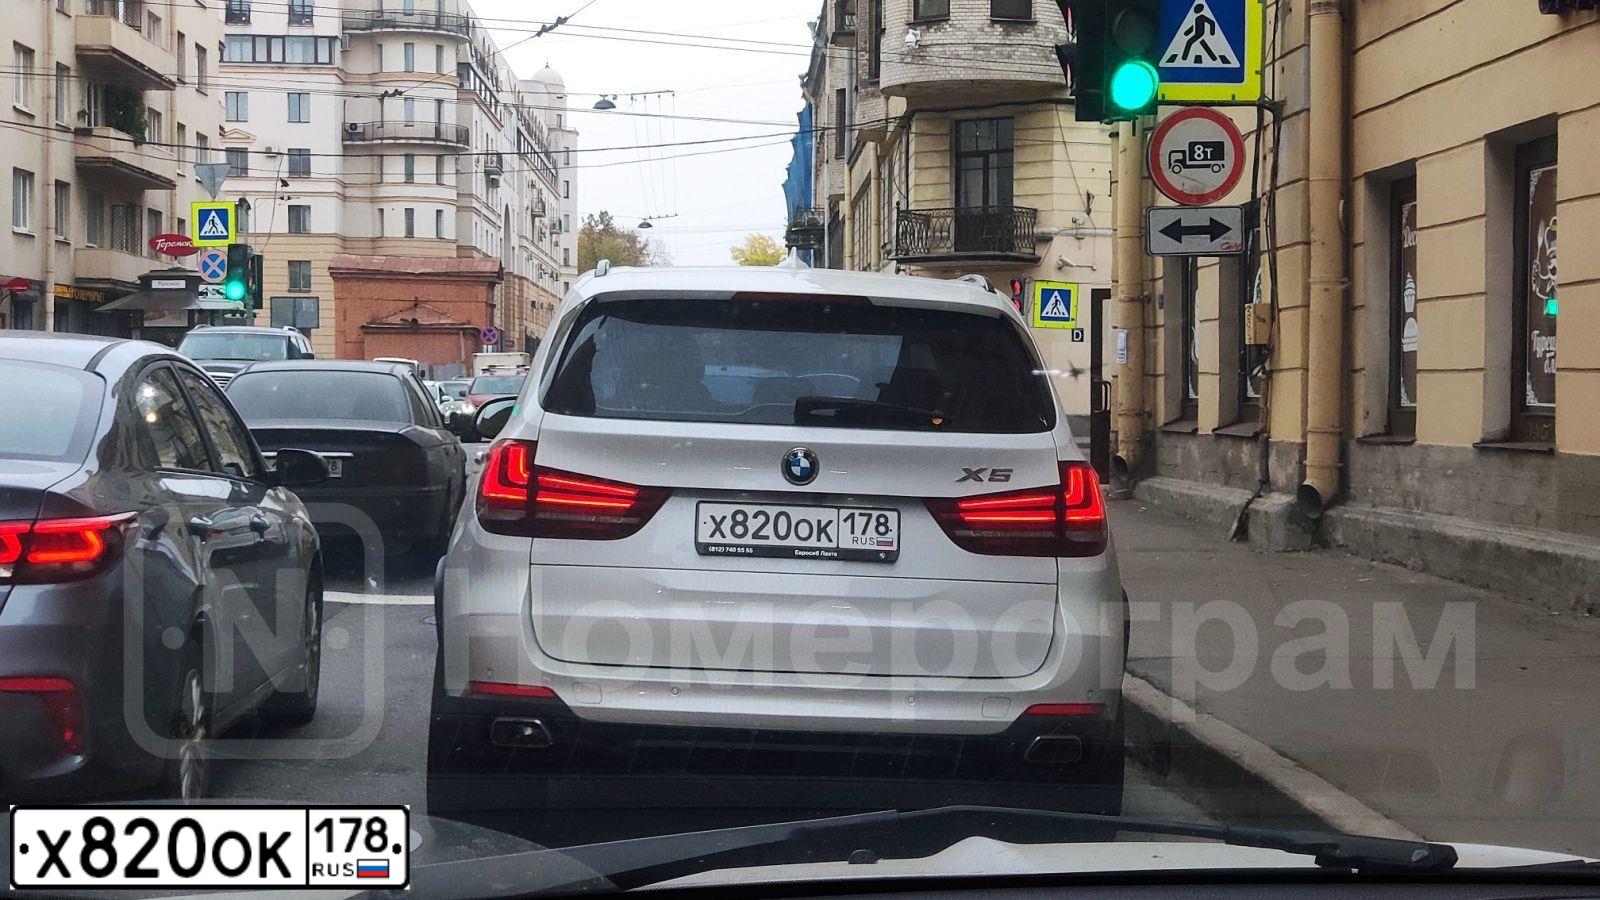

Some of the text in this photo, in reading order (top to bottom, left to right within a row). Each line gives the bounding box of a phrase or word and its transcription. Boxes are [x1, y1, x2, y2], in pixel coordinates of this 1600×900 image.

[155, 238, 194, 251] Теремок
[1073, 329, 1083, 342] D
[954, 467, 1014, 483] X5
[843, 512, 890, 536] 178
[852, 537, 876, 546] RUS
[708, 545, 724, 553] (812)
[794, 549, 820, 557] Евросиб
